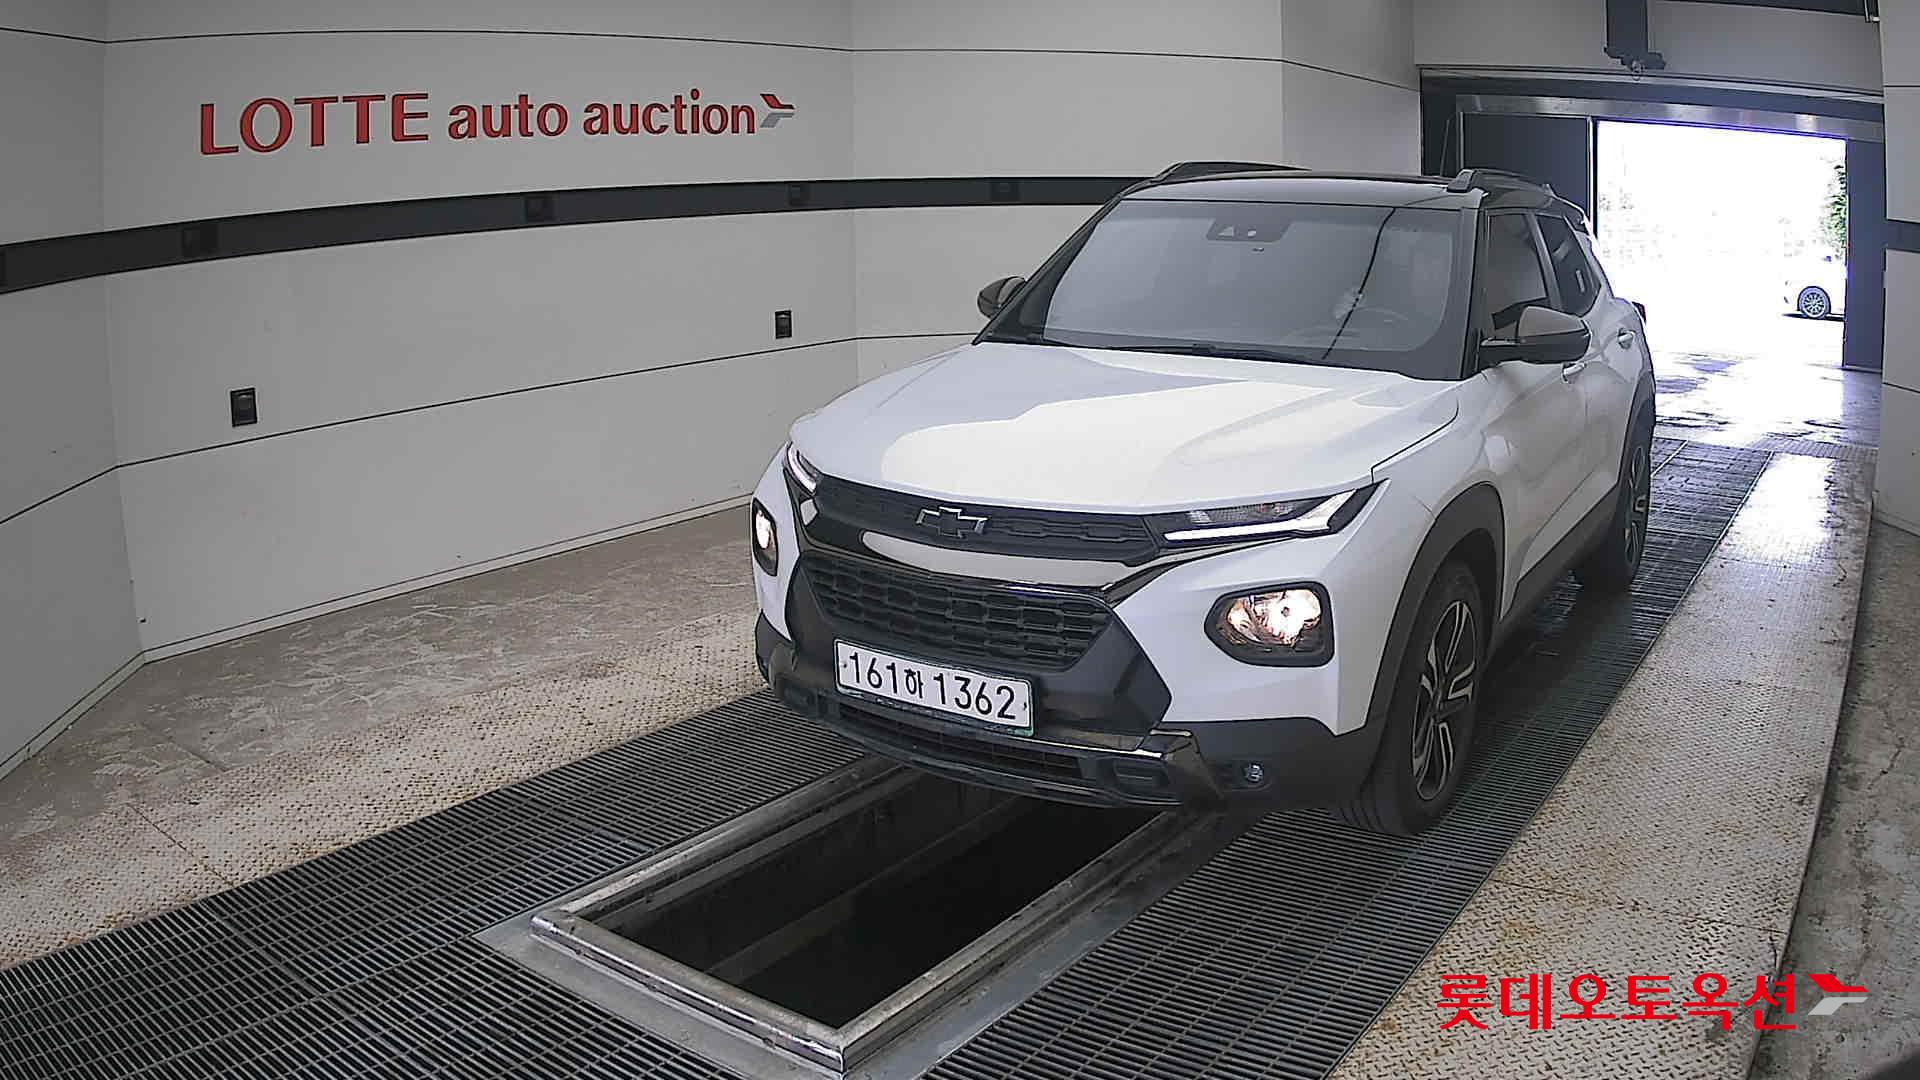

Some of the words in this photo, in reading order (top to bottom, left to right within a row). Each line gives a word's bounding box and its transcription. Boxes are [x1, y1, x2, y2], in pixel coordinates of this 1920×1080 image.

[200, 93, 429, 155] LOTTE
[448, 94, 569, 139] auto
[582, 88, 756, 135] auction
[849, 651, 924, 699] 161하
[933, 672, 1017, 720] 1362
